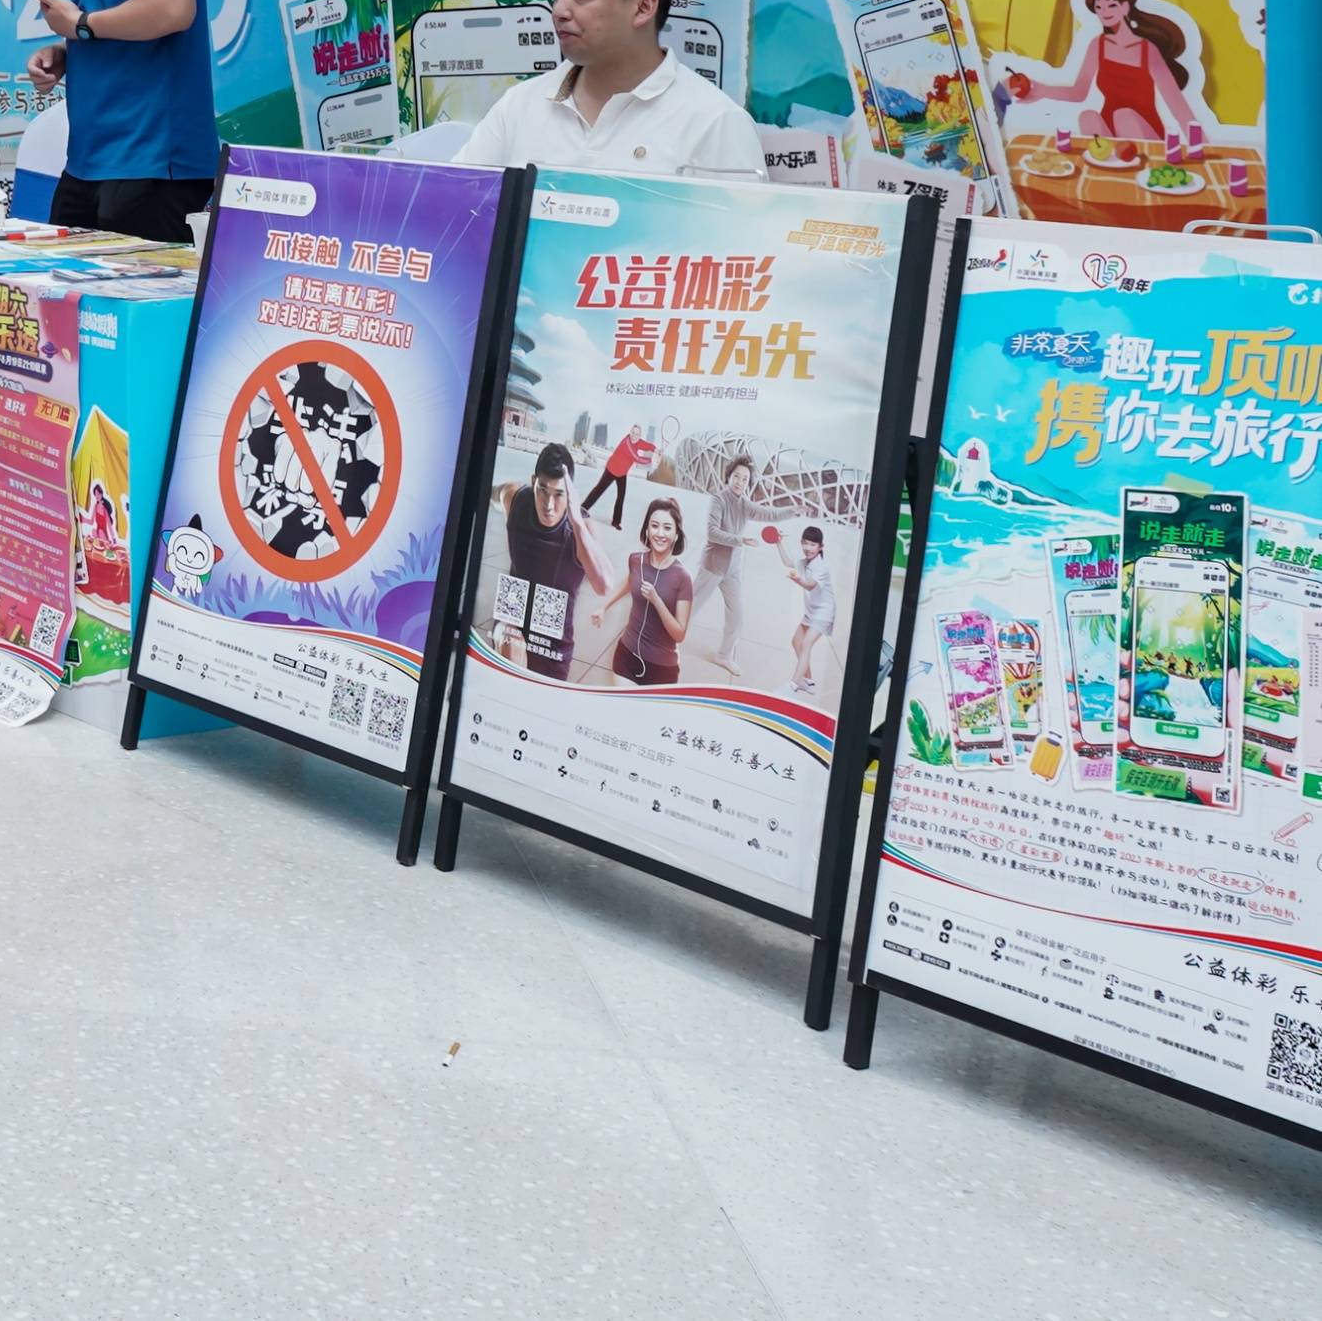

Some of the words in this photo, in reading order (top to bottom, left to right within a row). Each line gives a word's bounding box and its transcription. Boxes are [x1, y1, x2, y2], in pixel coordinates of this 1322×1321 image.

[313, 24, 390, 77] 说走就
[253, 190, 309, 207] 中国体育彩票
[876, 178, 898, 193] 体彩
[557, 204, 612, 219] 中国体育彩票
[264, 229, 342, 270] 不接触
[348, 240, 433, 283] 不参与
[574, 254, 776, 313] 公益体彩
[1117, 276, 1152, 294] 周年
[608, 316, 818, 381] 责任为先
[1010, 331, 1093, 360] 非常夏天
[604, 382, 677, 398] 体彩公益惠民生
[678, 384, 759, 401] 健康中国有担当
[1025, 378, 1322, 482] 携你去旅行
[1138, 519, 1227, 549] 说走就走
[1064, 558, 1116, 580] 说走就
[297, 643, 341, 667] 公益体彩
[343, 659, 390, 683] 乐善人生
[659, 725, 724, 758] 公益体彩
[729, 747, 799, 782] 乐善人生
[1183, 951, 1278, 995] 公益体彩
